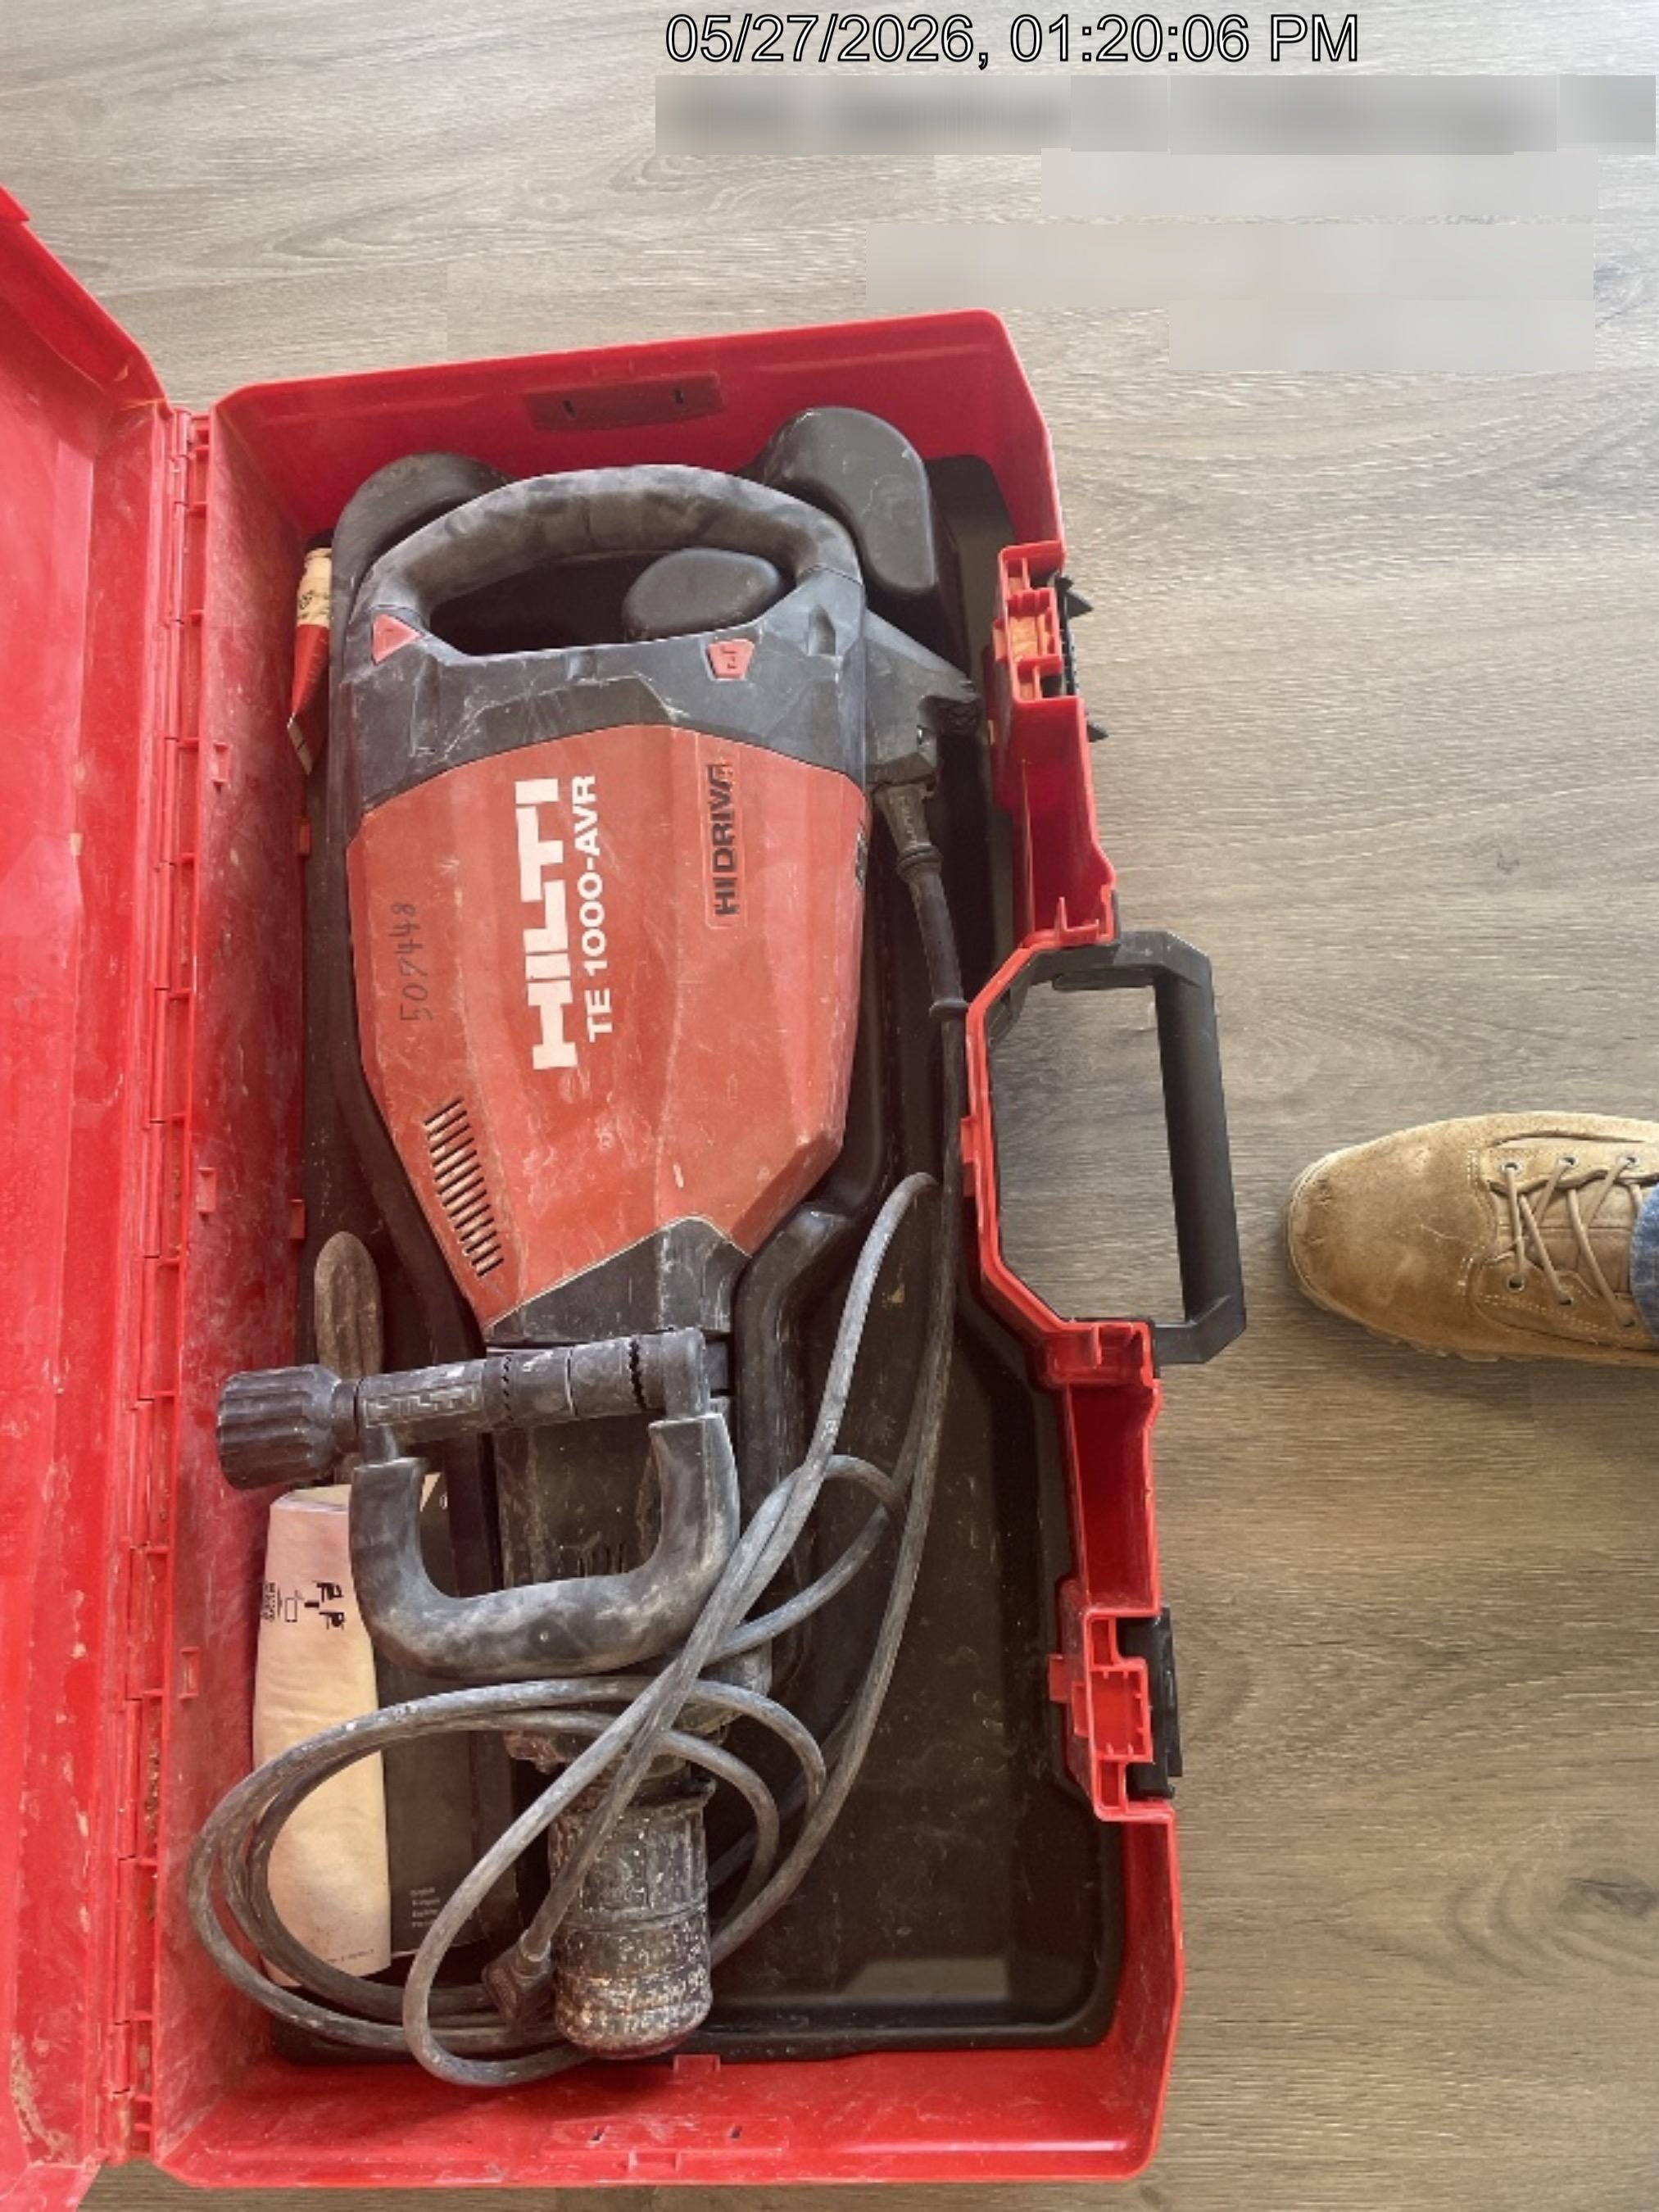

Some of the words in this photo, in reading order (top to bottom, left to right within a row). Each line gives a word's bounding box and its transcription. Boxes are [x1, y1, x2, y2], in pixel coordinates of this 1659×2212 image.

[514, 778, 578, 1070] HILTI
[572, 775, 608, 977] 1000-AVR
[584, 988, 613, 1043] TE
